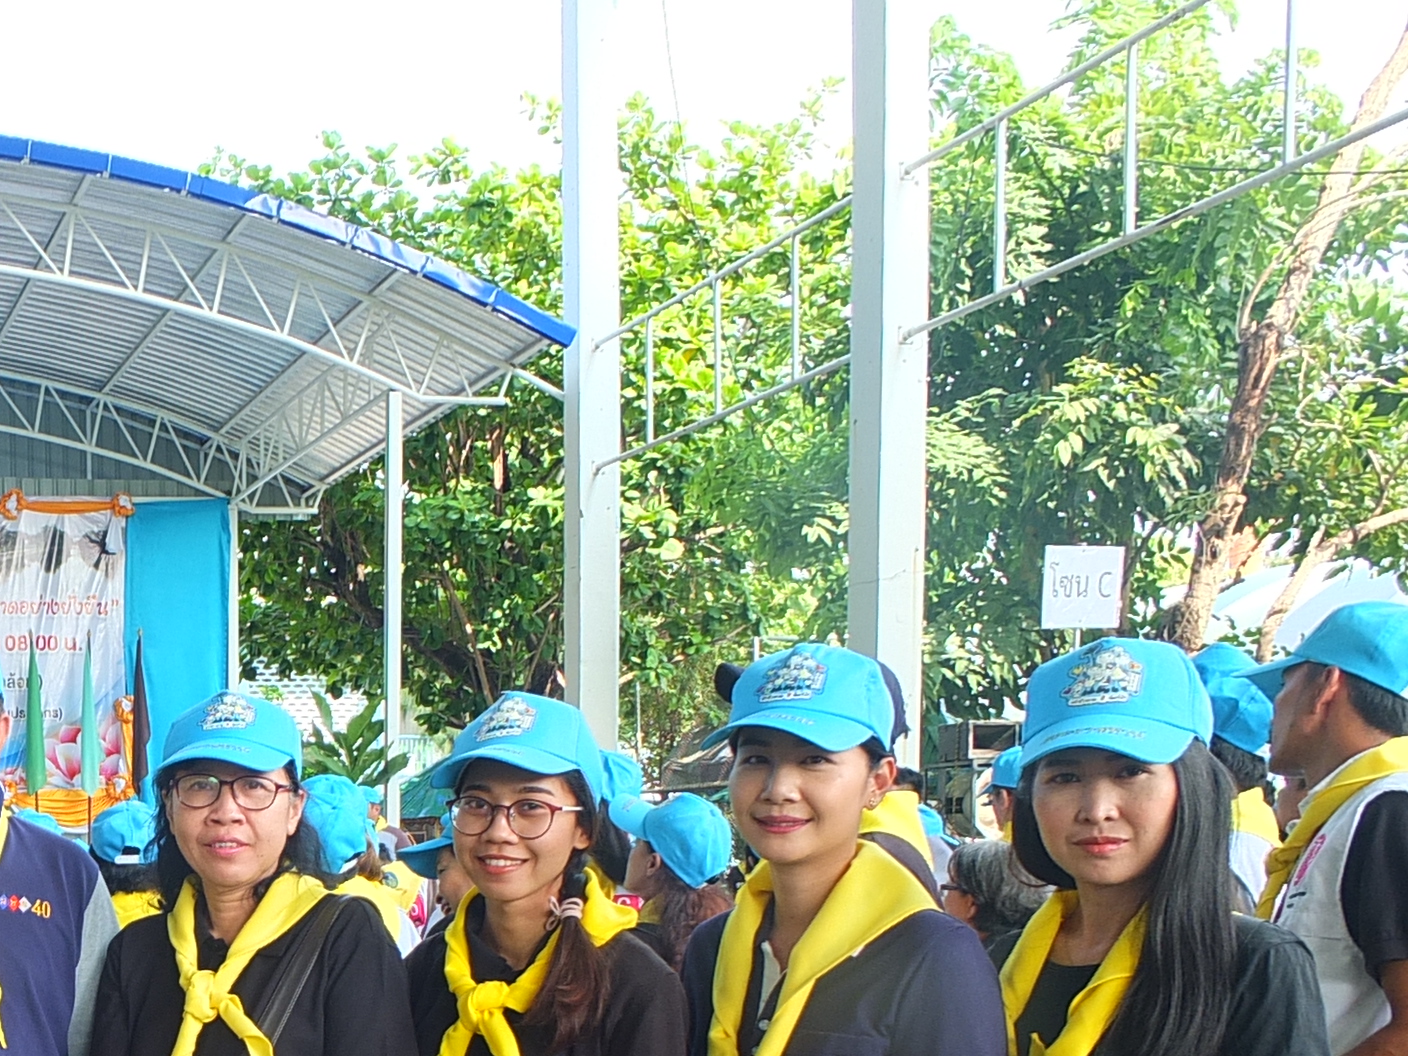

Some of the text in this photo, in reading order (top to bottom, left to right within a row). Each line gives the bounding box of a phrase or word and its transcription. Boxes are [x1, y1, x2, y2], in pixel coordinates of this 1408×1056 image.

[1049, 561, 1113, 598] โซน C
[31, 898, 51, 918] 40
